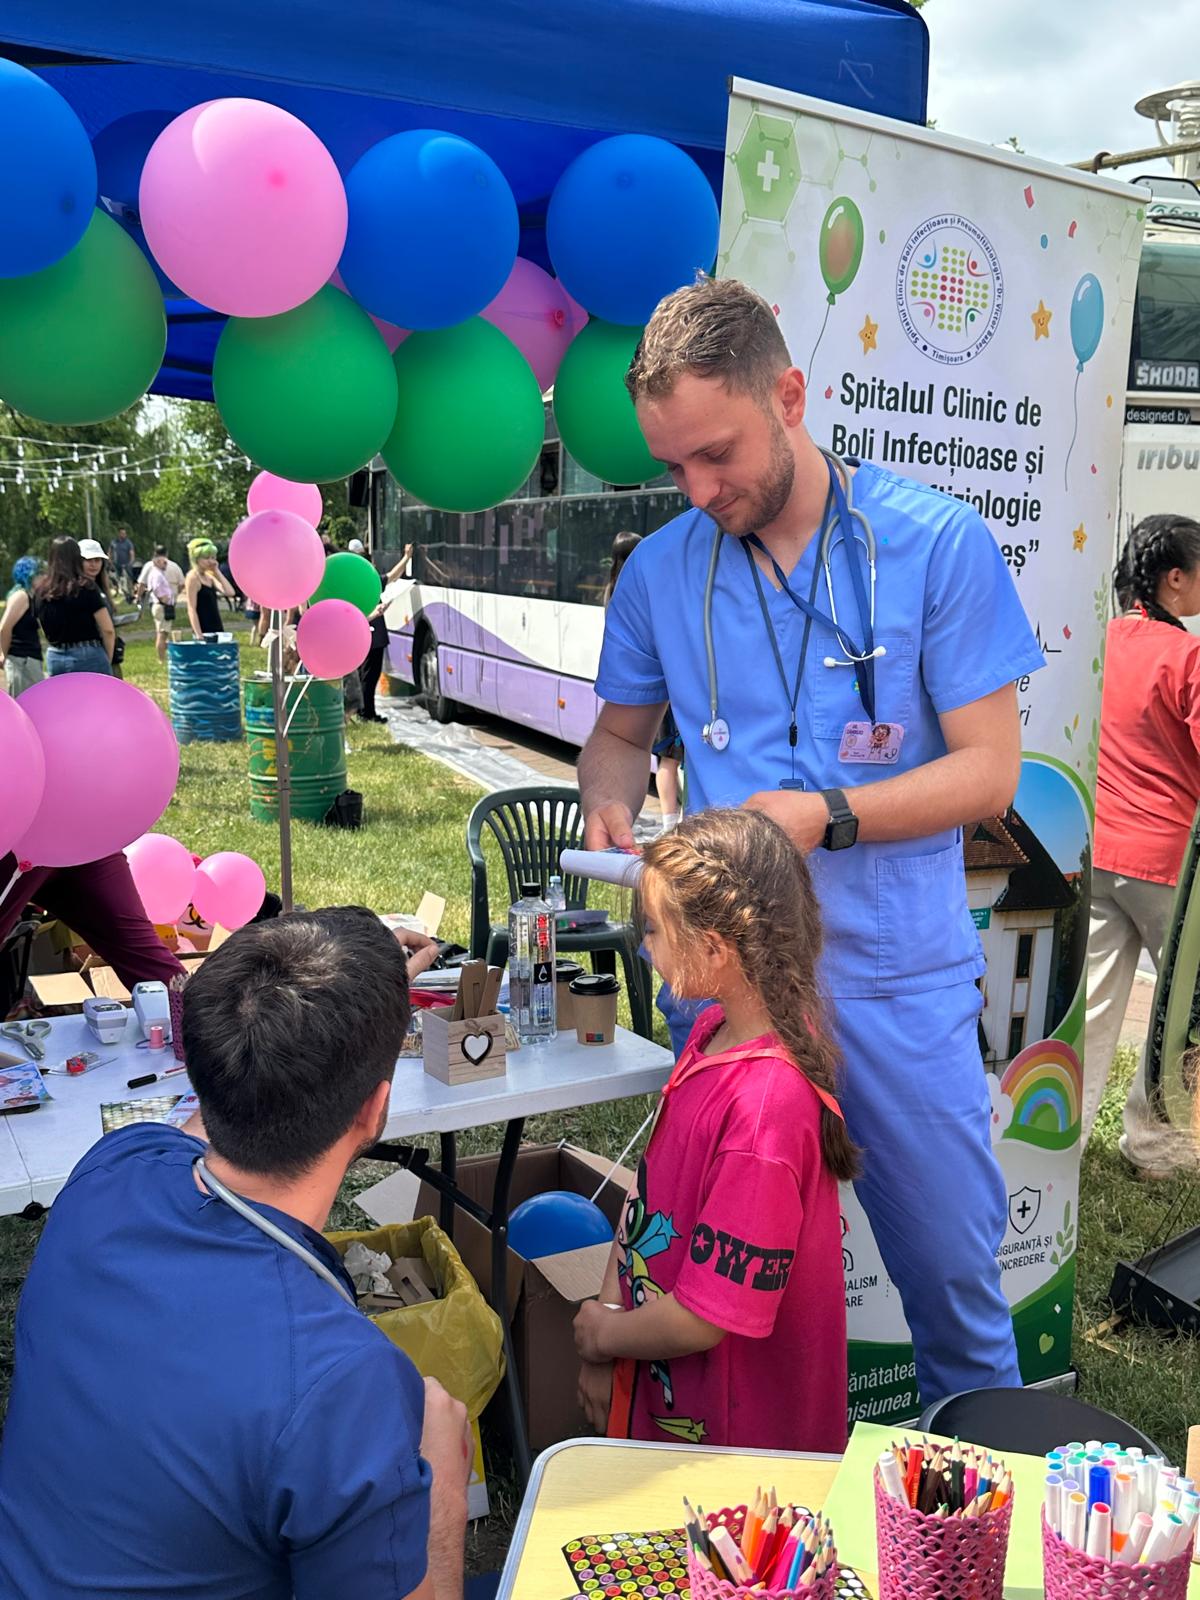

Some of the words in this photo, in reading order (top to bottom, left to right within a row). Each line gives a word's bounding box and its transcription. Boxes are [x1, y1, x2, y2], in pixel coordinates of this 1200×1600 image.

[1136, 362, 1199, 387] ŠKODA
[840, 372, 934, 414] Spitalul
[943, 385, 1007, 423] Clinic
[1015, 396, 1041, 427] de
[1126, 408, 1175, 424] designed
[1177, 410, 1192, 425] by
[832, 424, 875, 460] Boli
[882, 430, 1018, 477] Infecțioase
[1025, 445, 1044, 484] și
[690, 1223, 795, 1292] OWER
[845, 1295, 864, 1308] ARE
[848, 1361, 916, 1393] ănătatea
